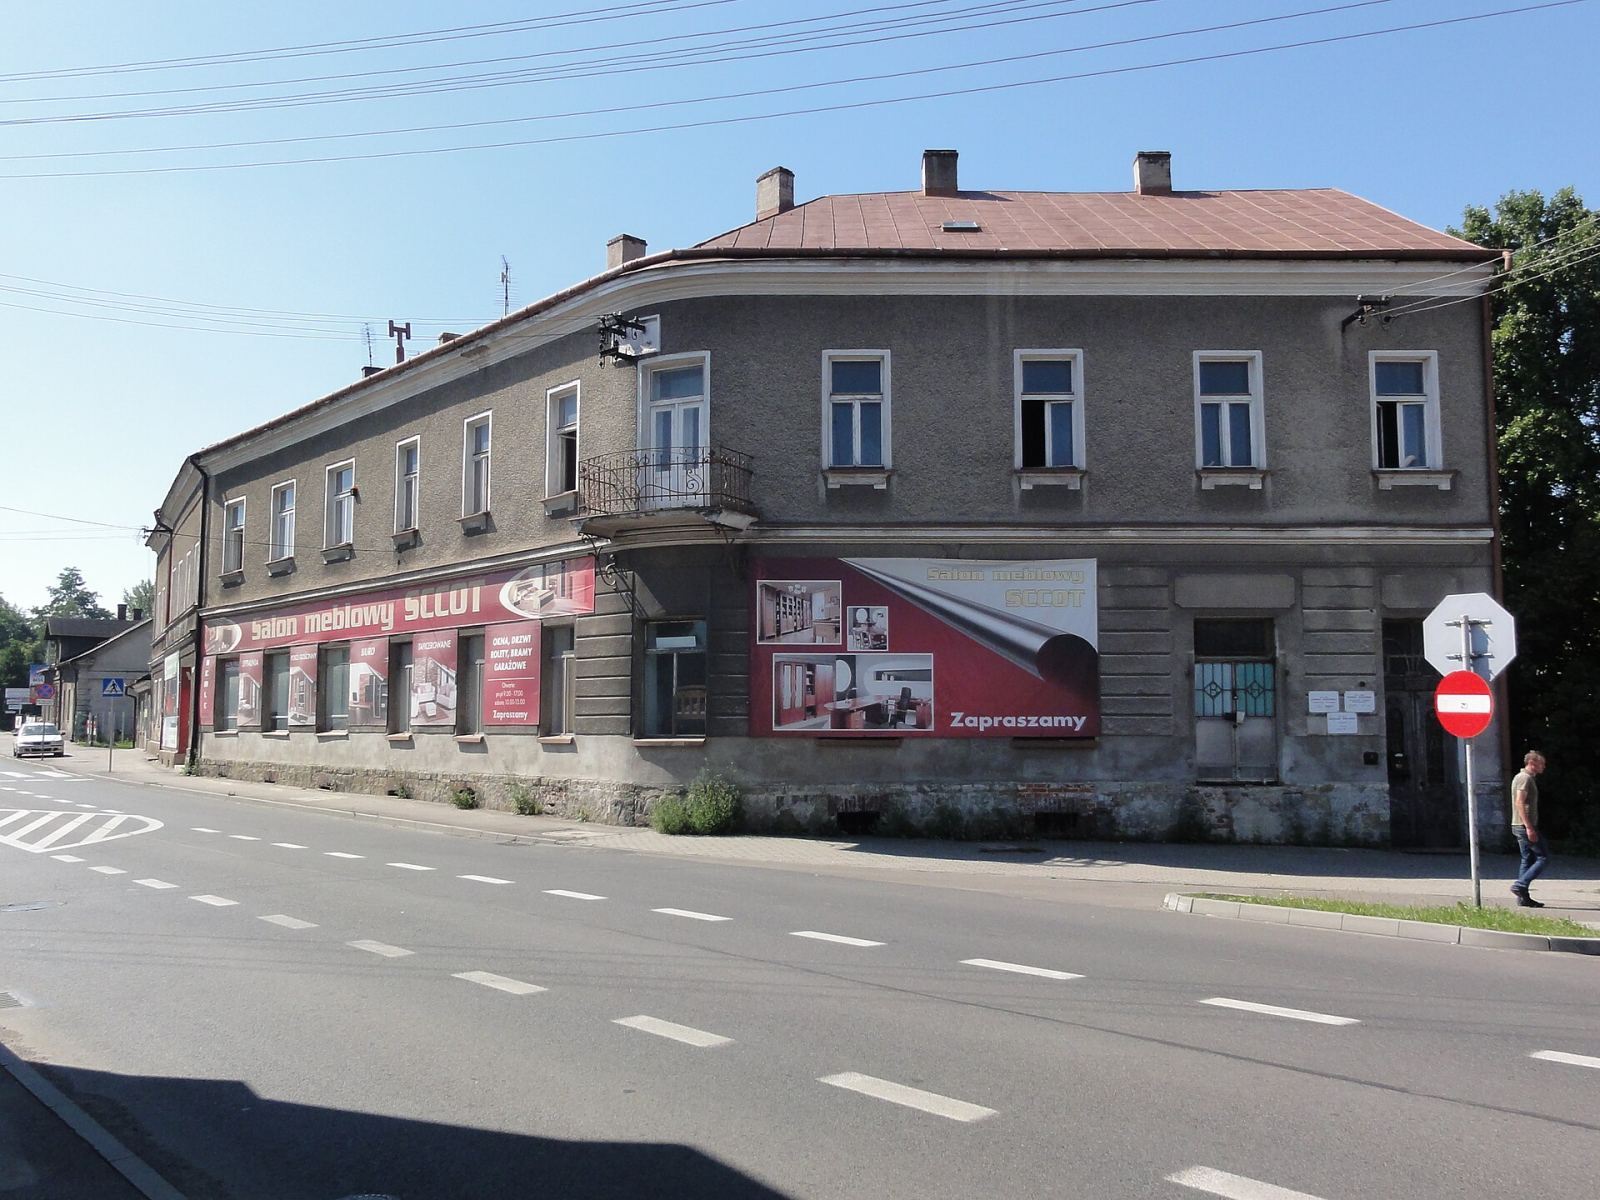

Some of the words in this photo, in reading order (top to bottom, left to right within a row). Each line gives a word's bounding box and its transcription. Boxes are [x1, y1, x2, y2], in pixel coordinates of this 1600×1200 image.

[927, 567, 984, 581] Salon
[992, 568, 1084, 584] meblowy
[1005, 589, 1085, 607] SCCOT
[252, 616, 297, 640] Salon
[304, 601, 395, 631] meblowy
[404, 580, 486, 621] SCCOT
[494, 660, 527, 671] GARAŻOWE
[492, 709, 528, 720] Zapraszamy
[950, 712, 1087, 732] Zapraszamy
